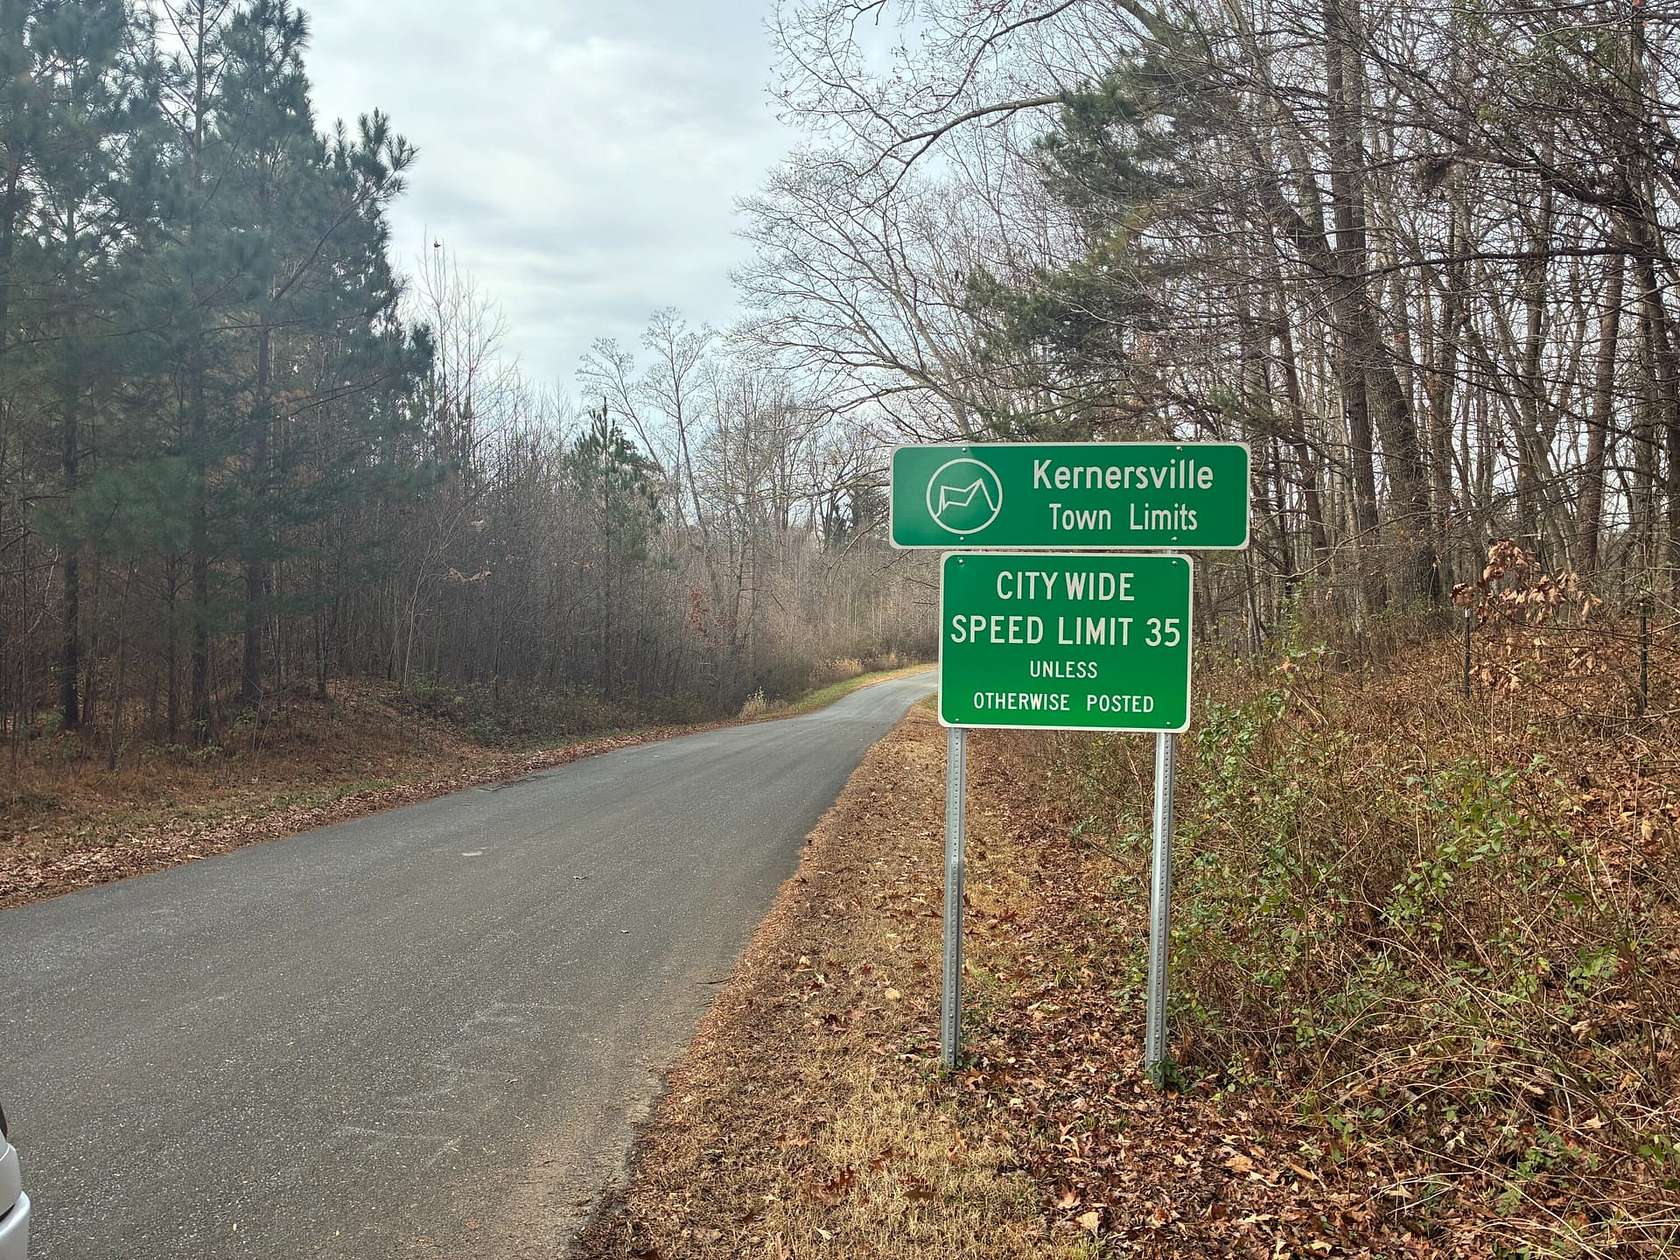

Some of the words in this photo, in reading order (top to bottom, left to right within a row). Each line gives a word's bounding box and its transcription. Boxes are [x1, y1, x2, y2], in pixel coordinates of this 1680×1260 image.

[1033, 458, 1214, 490] Kernersville
[1049, 503, 1111, 530] Town
[1130, 503, 1198, 531] Limits
[996, 571, 1058, 600] CITY
[1065, 572, 1135, 601] WIDE
[950, 614, 1044, 644] SPEED
[1058, 616, 1134, 646] LIMIT
[1145, 617, 1181, 647] 35
[1030, 660, 1098, 679] UNLESS
[973, 691, 1070, 711] OTHERWISE
[1087, 694, 1154, 713] POSTED
